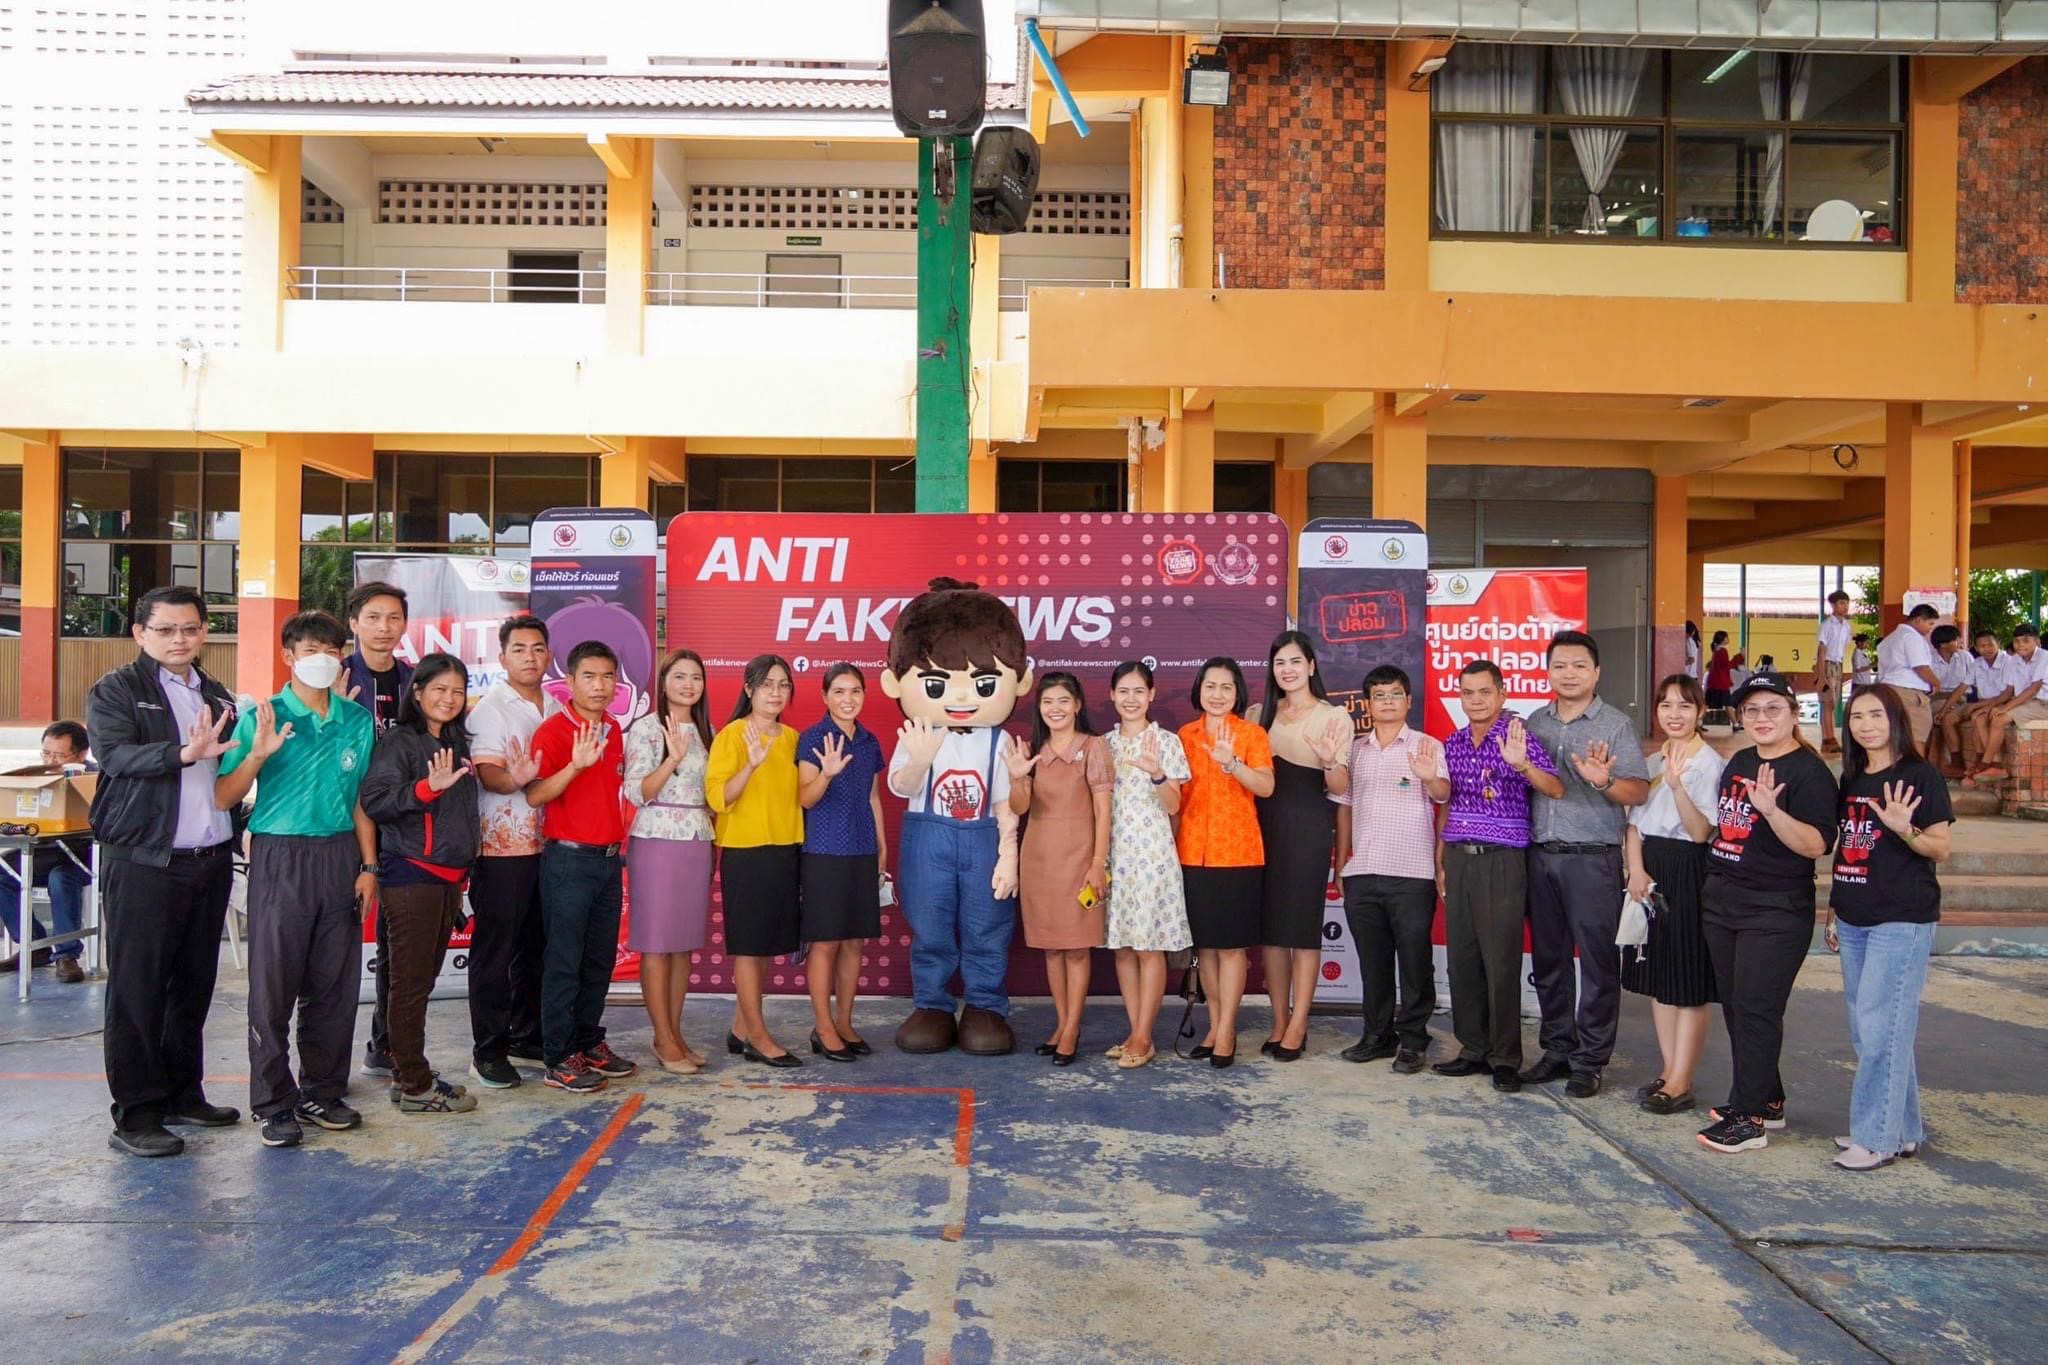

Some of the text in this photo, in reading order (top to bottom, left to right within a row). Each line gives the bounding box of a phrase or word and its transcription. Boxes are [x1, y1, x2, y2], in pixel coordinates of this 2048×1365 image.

[696, 536, 850, 583] ANTI
[535, 570, 621, 582] เช็คให้ชัวร์ ก่อนแชร์
[1348, 600, 1378, 616] ข่าว
[1338, 616, 1385, 633] ปลอม
[1791, 648, 1800, 661] 3
[1718, 796, 1752, 816] FAKE
